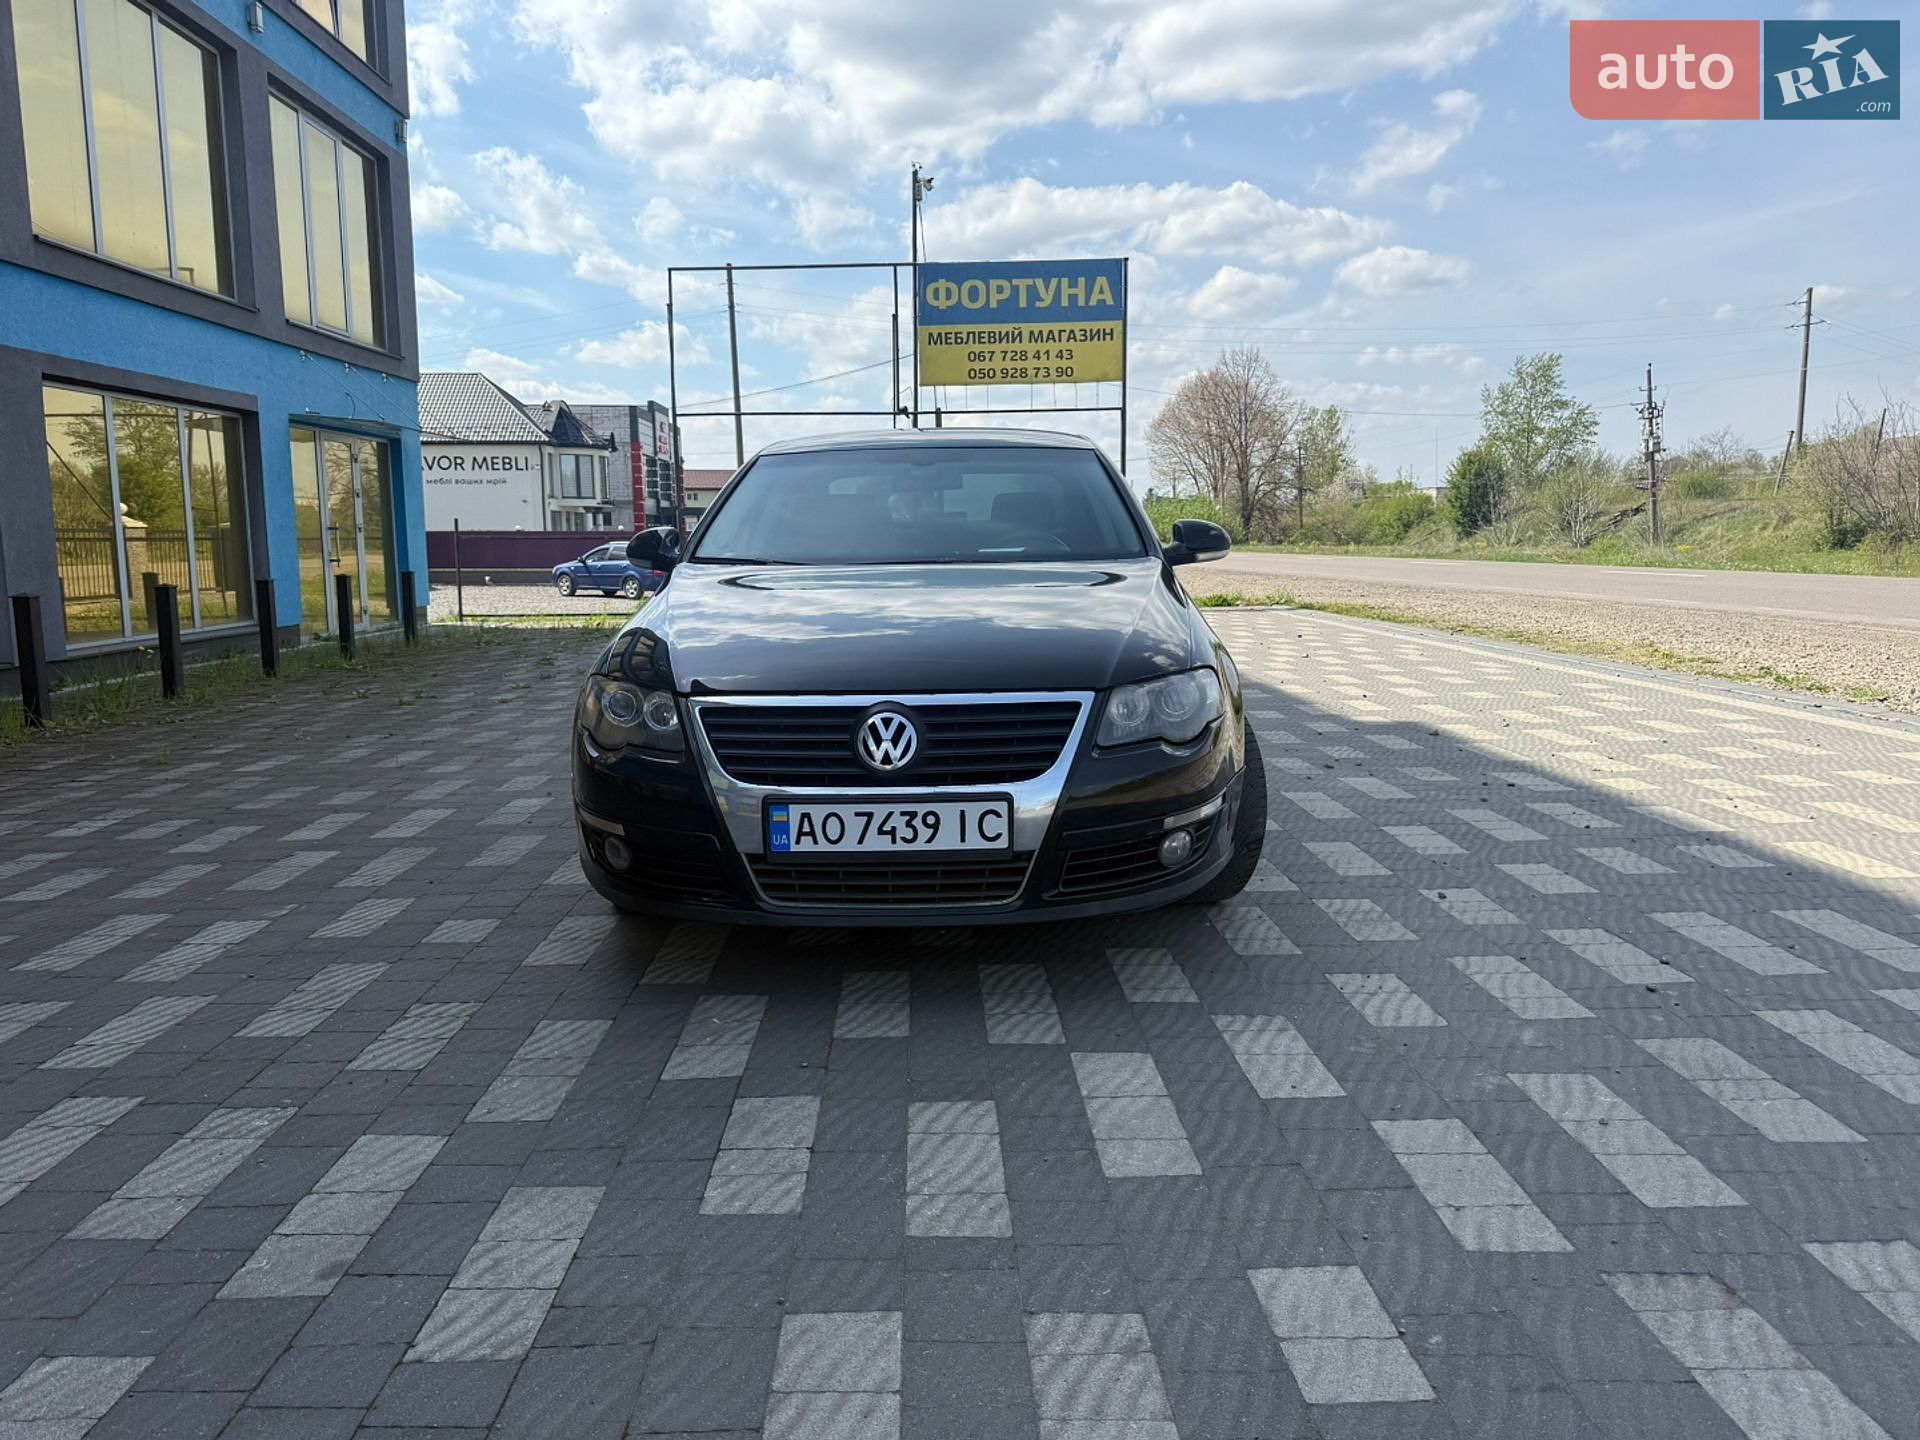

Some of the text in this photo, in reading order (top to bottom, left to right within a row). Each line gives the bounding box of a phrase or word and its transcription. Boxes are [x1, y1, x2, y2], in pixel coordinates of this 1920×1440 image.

[925, 275, 1115, 310] ФОРТУНА
[927, 327, 1115, 346] МЕБЛЕВИЙ МАГАЗИН
[967, 349, 1074, 363] 067 728 41 43
[967, 366, 1074, 380] 050 928 73 90
[471, 455, 529, 471] MEBLI
[794, 808, 1003, 846] AO 7439 IC
[773, 834, 789, 845] UA
